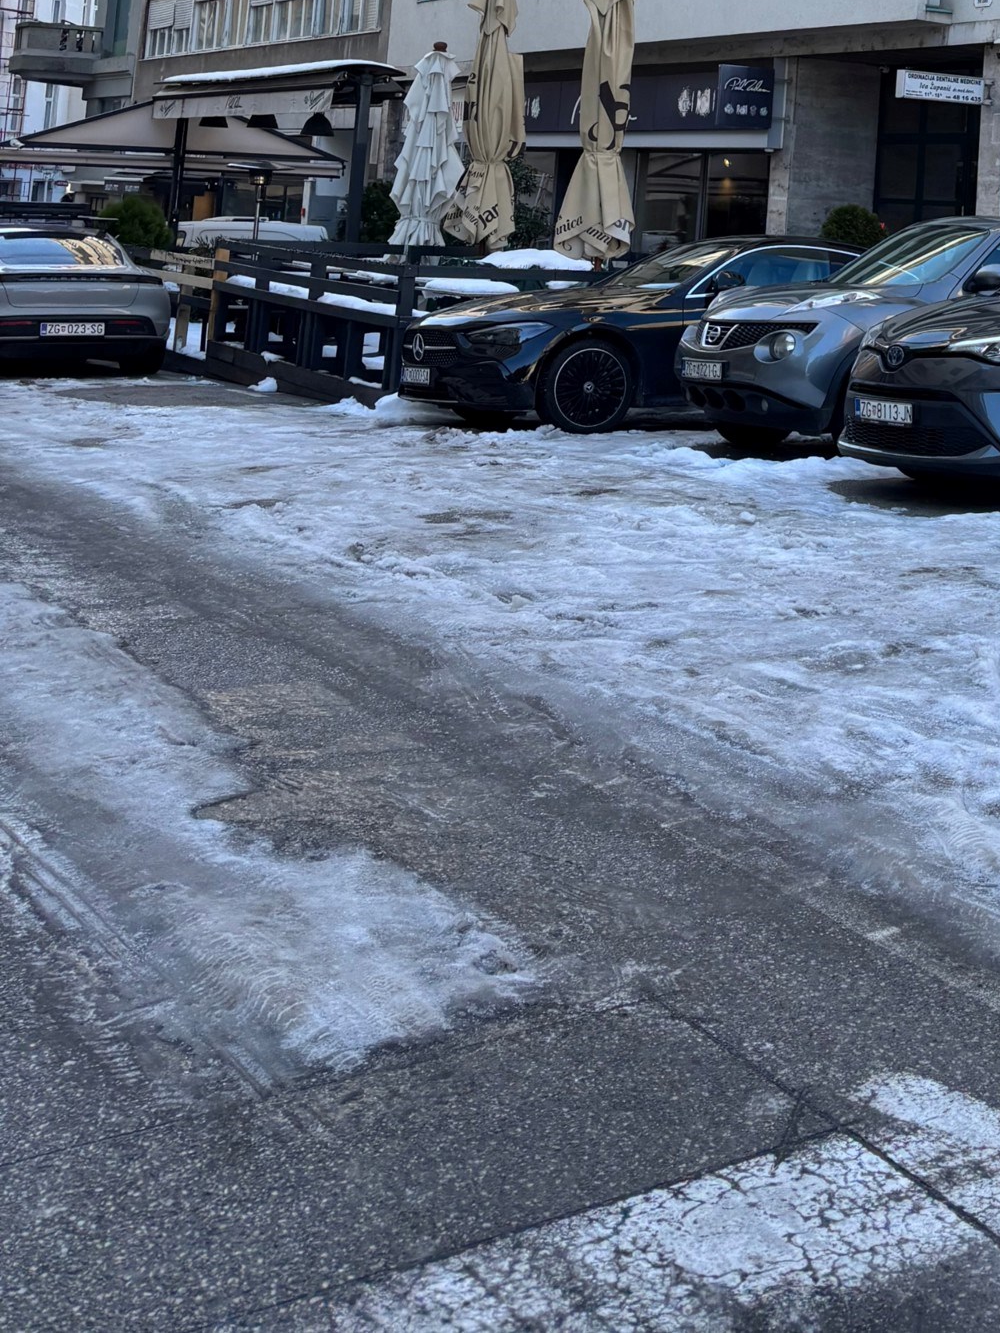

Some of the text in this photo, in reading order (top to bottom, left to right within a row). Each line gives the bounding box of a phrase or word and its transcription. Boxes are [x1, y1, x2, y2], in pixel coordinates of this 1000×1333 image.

[936, 75, 959, 83] DENTALNE
[960, 78, 982, 86] MEDICINE
[48, 324, 60, 334] ZG
[860, 401, 872, 418] ZG
